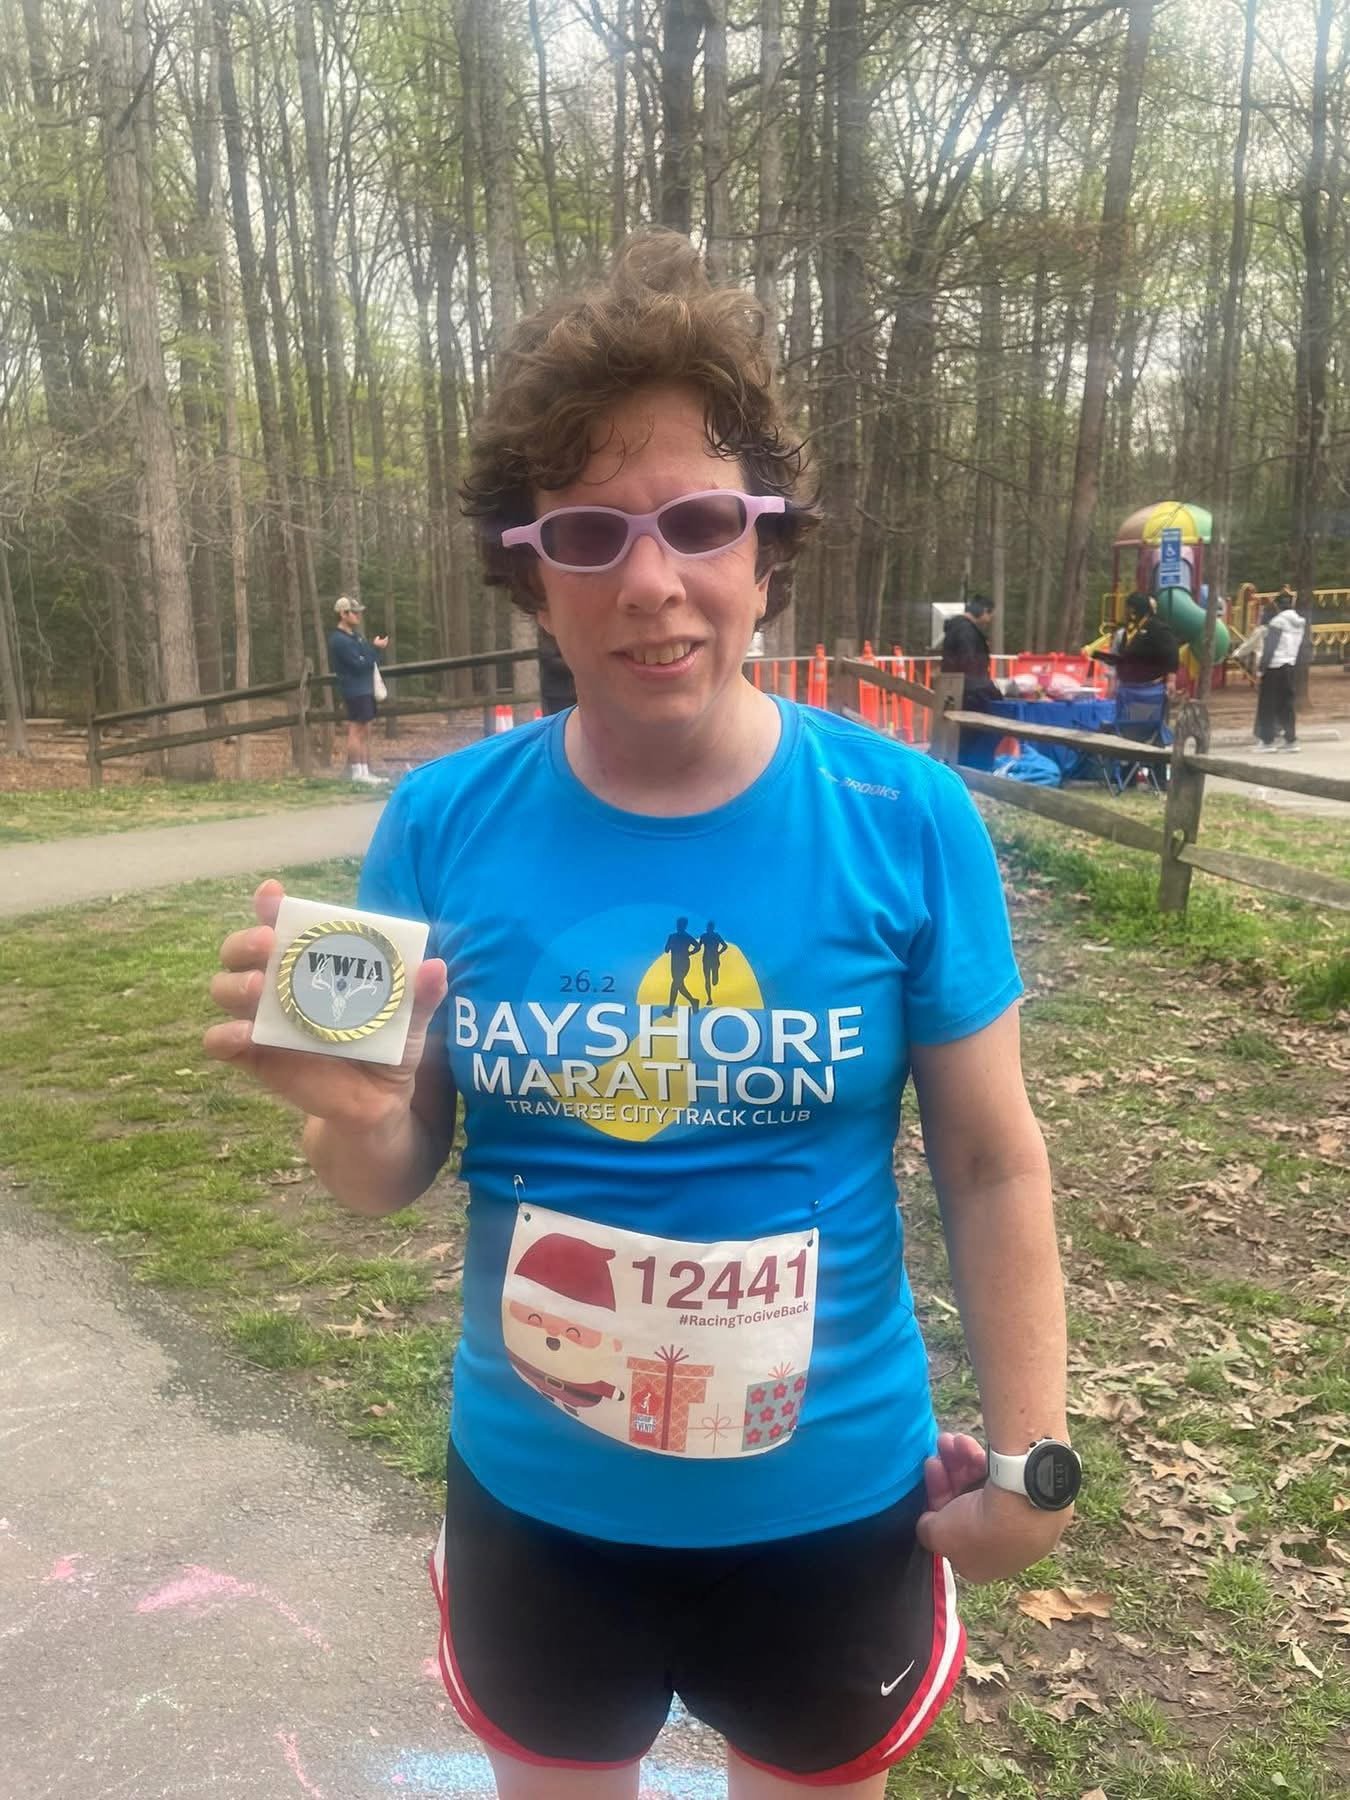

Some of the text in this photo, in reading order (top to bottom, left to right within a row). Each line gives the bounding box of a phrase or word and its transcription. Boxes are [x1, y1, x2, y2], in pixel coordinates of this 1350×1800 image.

[844, 776, 900, 801] ROOKS
[307, 951, 384, 982] WWIA
[559, 969, 616, 994] 26.2
[455, 995, 864, 1064] BAYSHORE
[472, 1052, 835, 1106] MARATHON
[505, 1099, 811, 1126] TRAVERSE CITY TRACK CLUB
[632, 1249, 808, 1310] 12441
[679, 1300, 810, 1329] #RacingToGiveBack
